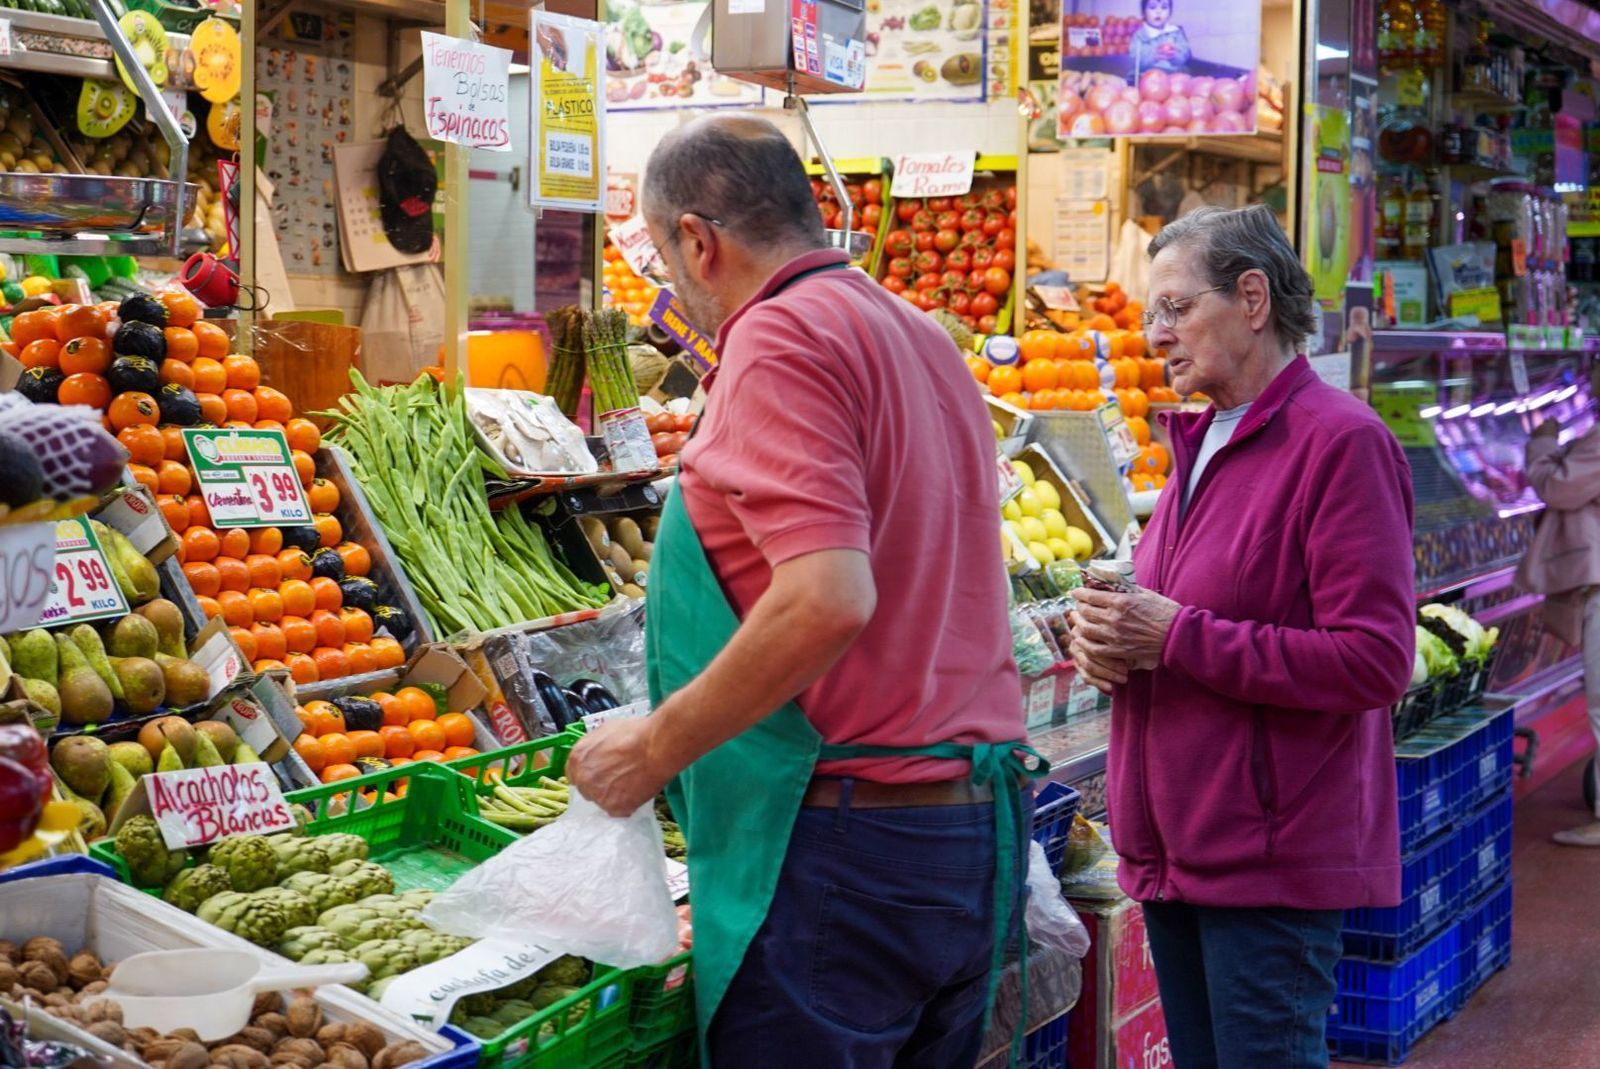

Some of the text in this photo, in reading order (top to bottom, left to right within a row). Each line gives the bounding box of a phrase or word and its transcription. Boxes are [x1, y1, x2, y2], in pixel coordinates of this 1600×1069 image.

[428, 96, 509, 148] Espinacas
[280, 509, 303, 518] KILO
[91, 598, 117, 609] KILO
